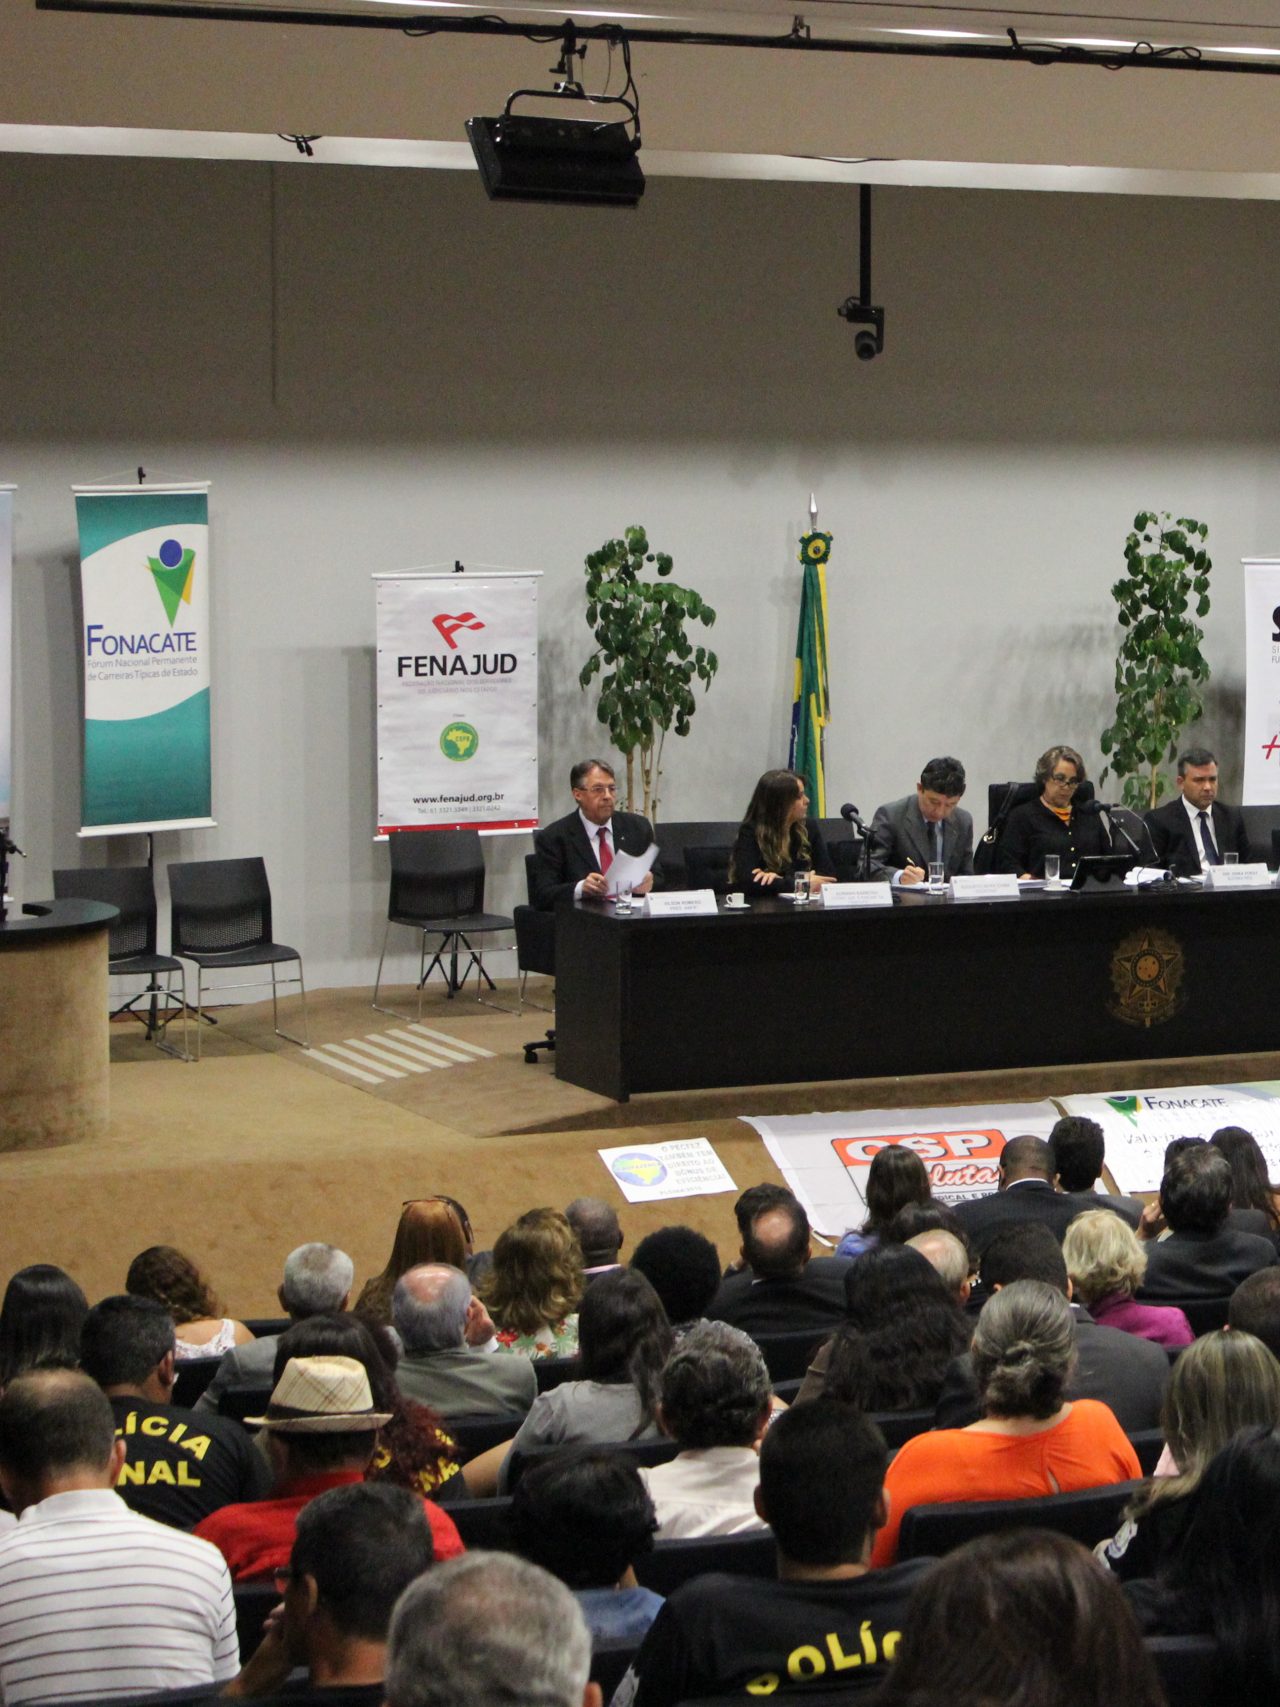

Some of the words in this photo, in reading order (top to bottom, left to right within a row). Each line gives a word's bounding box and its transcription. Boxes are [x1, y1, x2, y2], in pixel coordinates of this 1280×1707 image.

[87, 624, 197, 656] FONACATE
[115, 658, 150, 667] Nacional
[152, 656, 197, 666] Permanente
[398, 653, 517, 677] FENAJUD
[173, 667, 198, 677] Estado
[413, 792, 504, 804] www.fenajud.org.br
[1144, 1095, 1229, 1110] FONACATE
[930, 1163, 1000, 1187] luta
[934, 1192, 969, 1201] DICAL
[114, 1411, 211, 1460] ÍCIA
[117, 1461, 201, 1487] NAL
